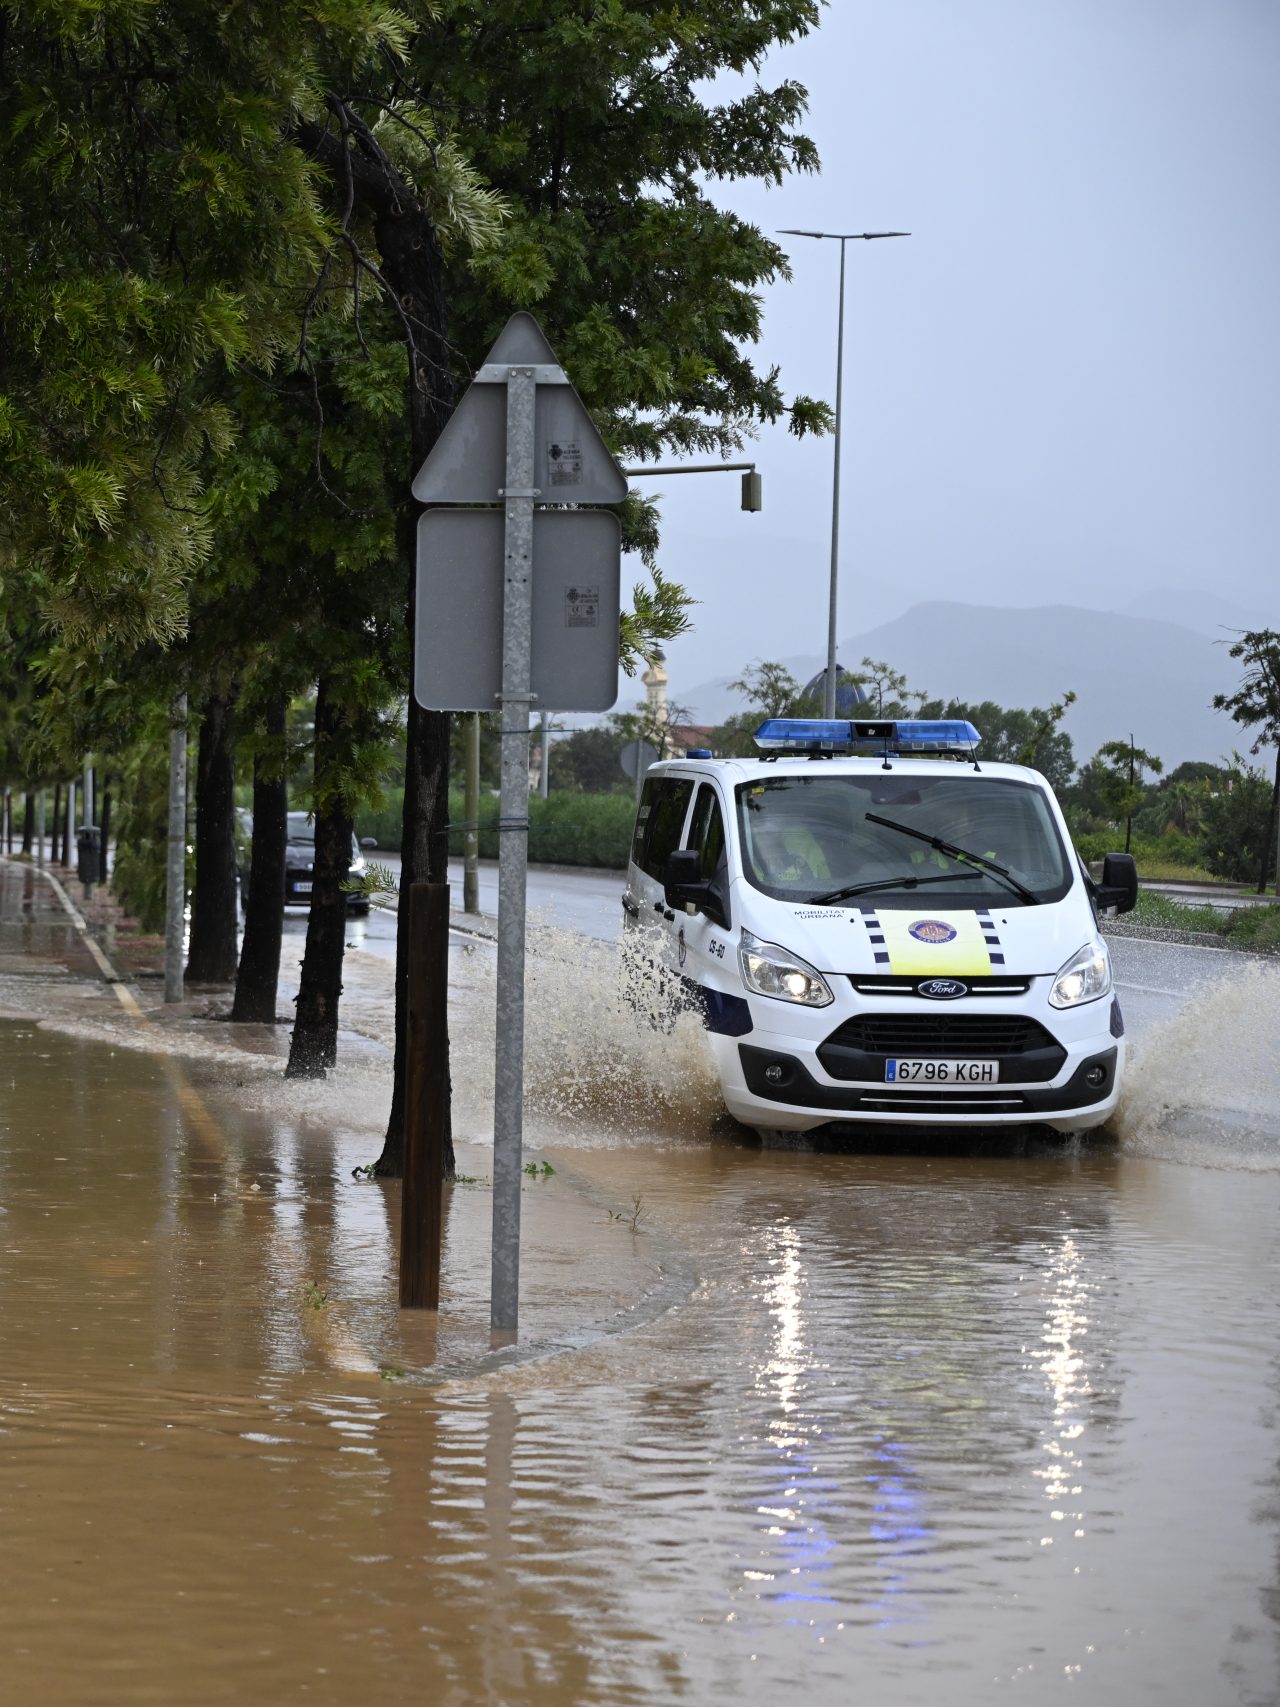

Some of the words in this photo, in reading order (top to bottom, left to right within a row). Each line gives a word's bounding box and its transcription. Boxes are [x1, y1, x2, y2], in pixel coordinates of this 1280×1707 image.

[929, 981, 956, 994] Ford
[898, 1062, 949, 1080] 6796
[955, 1063, 993, 1081] KGH
